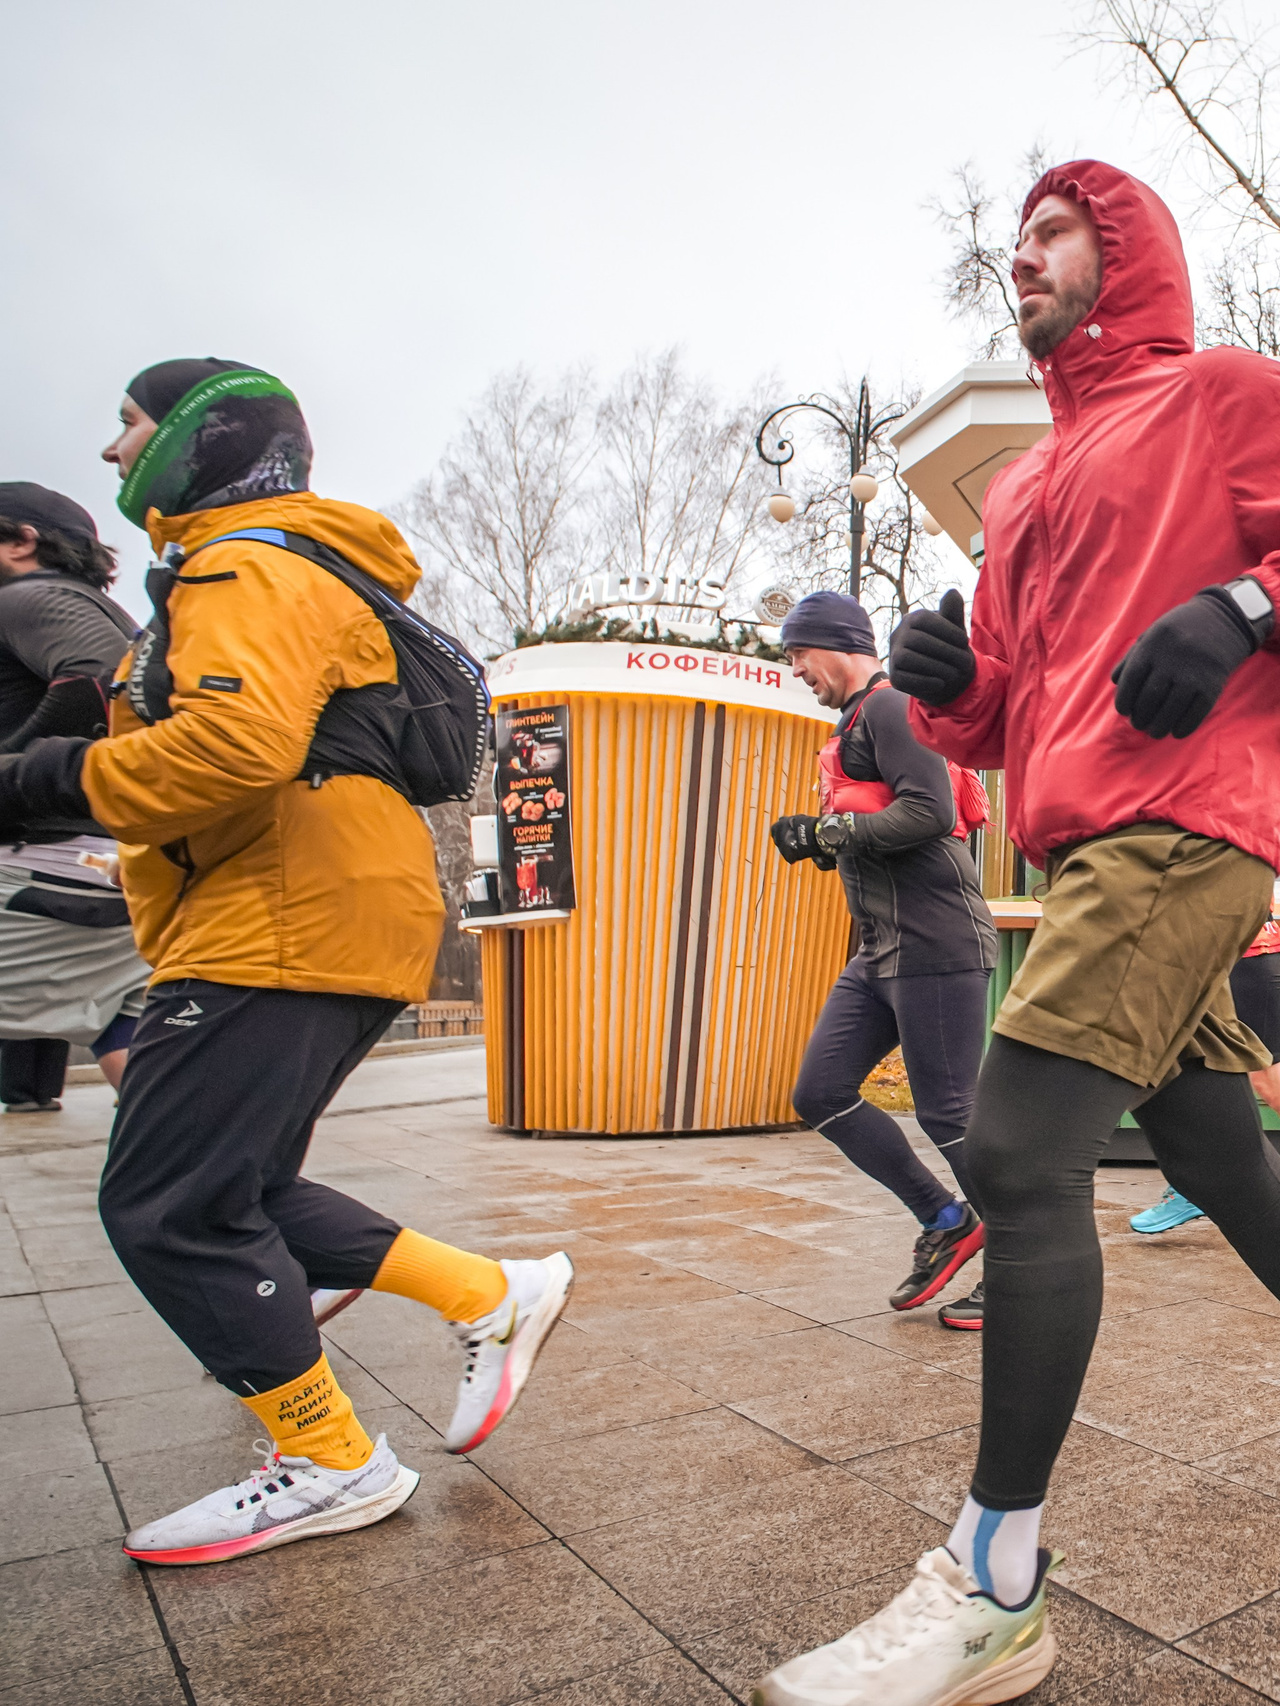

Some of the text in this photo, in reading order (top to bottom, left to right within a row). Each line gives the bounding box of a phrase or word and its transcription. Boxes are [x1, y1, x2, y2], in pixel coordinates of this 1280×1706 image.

[627, 653, 781, 688] КОФЕЙНЯ
[505, 711, 555, 729] ГЛИНТВЕЙН
[509, 776, 554, 790] ВЫПЕЧКА
[512, 823, 554, 837] ГОРЯЧИЕ
[515, 833, 551, 844] НАПИТКИ
[163, 1017, 199, 1027] DEM
[278, 1385, 333, 1422] РОДИНУ
